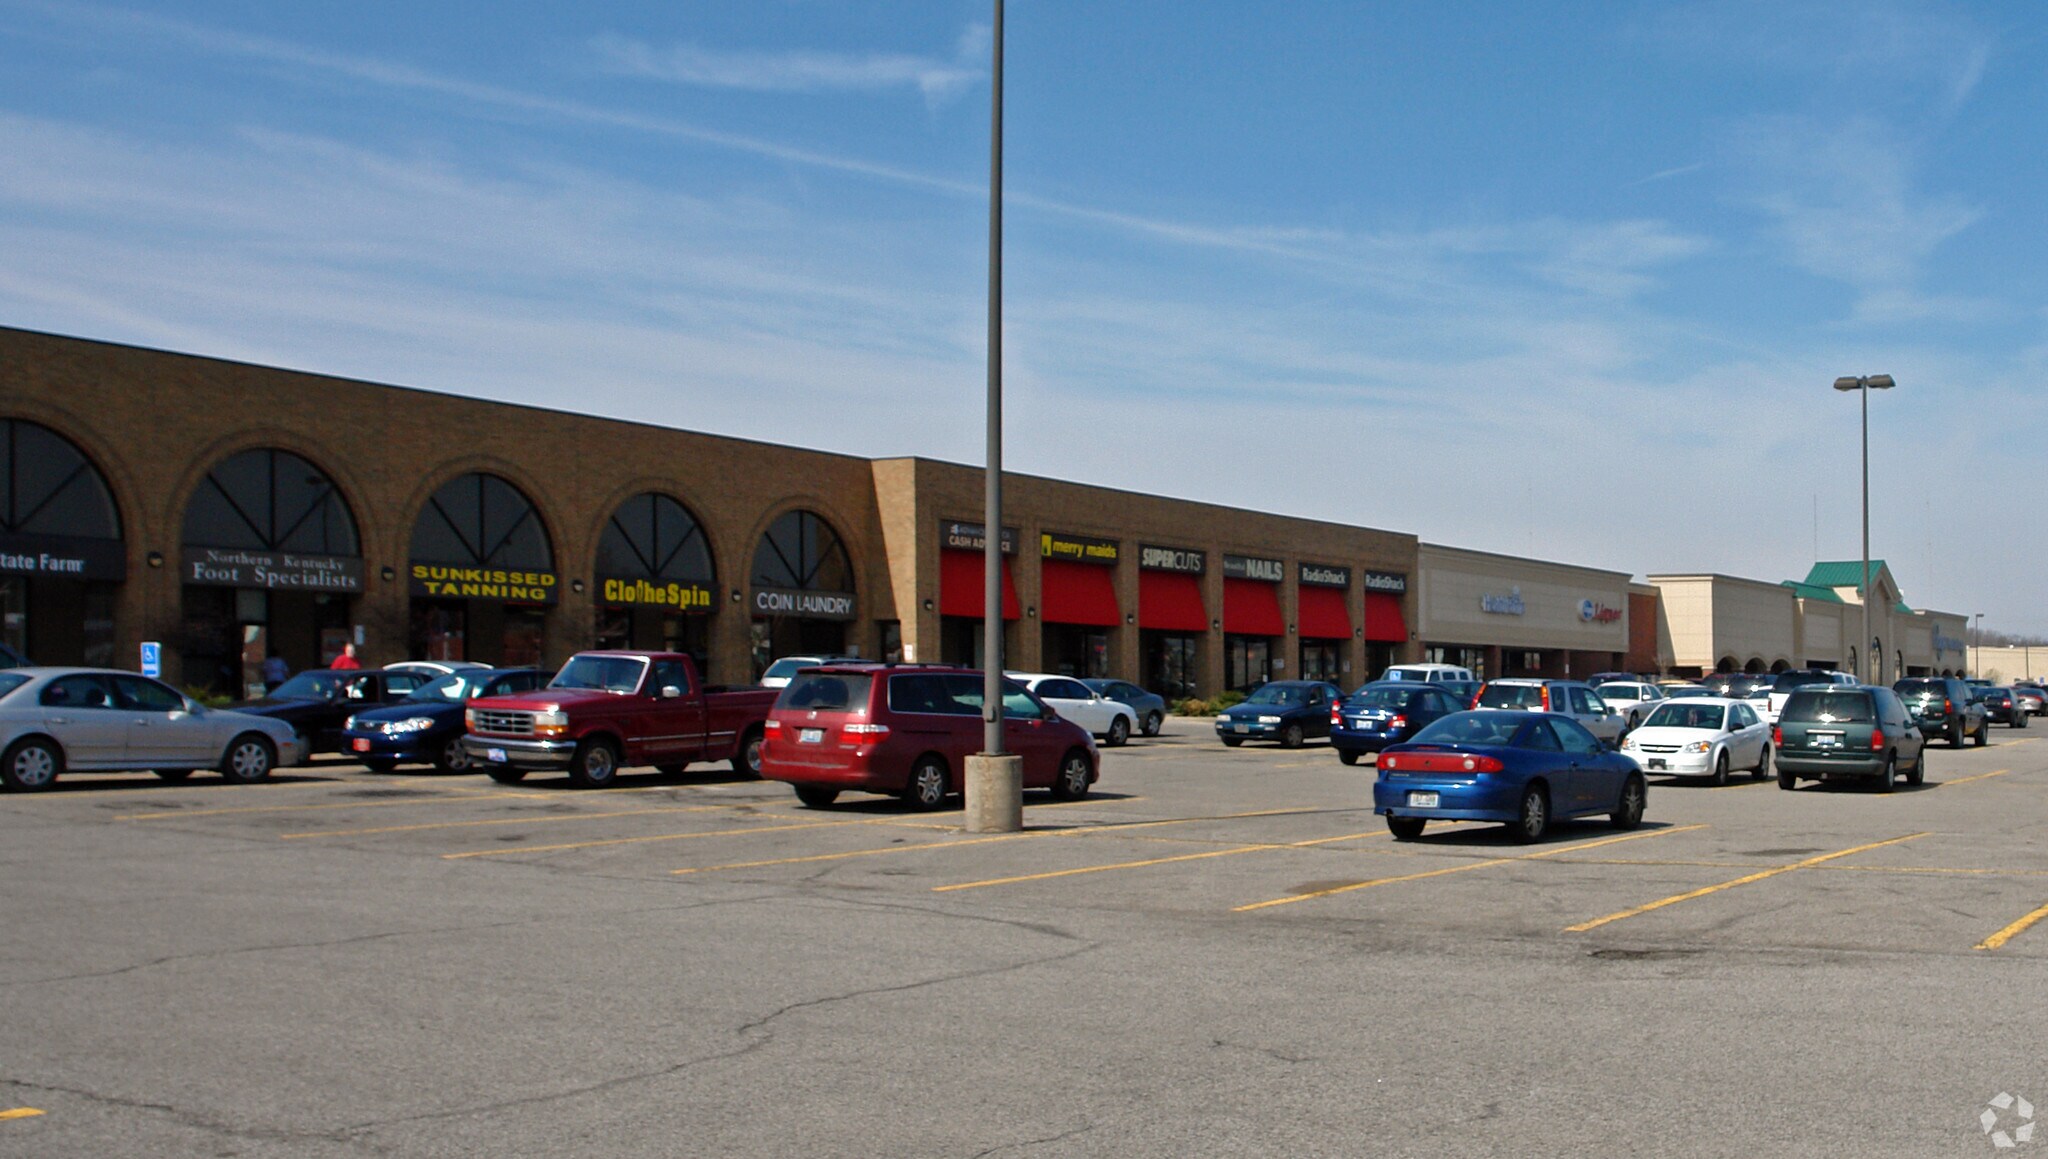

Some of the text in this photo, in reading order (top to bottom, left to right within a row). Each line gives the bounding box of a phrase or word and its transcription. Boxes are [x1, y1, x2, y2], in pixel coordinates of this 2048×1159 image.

[973, 537, 1011, 553] ADCE
[1053, 540, 1117, 559] merry maids
[0, 553, 84, 573] tate Farm
[207, 549, 345, 571] Northern Kentucky
[1141, 547, 1201, 572] SUPERCUTS
[1246, 558, 1283, 581] NAILS
[192, 561, 357, 588] Foot Specialists
[412, 565, 556, 587] SUNKISSED
[424, 581, 547, 600] TANNING
[756, 591, 852, 614] COIN LAUNDRY
